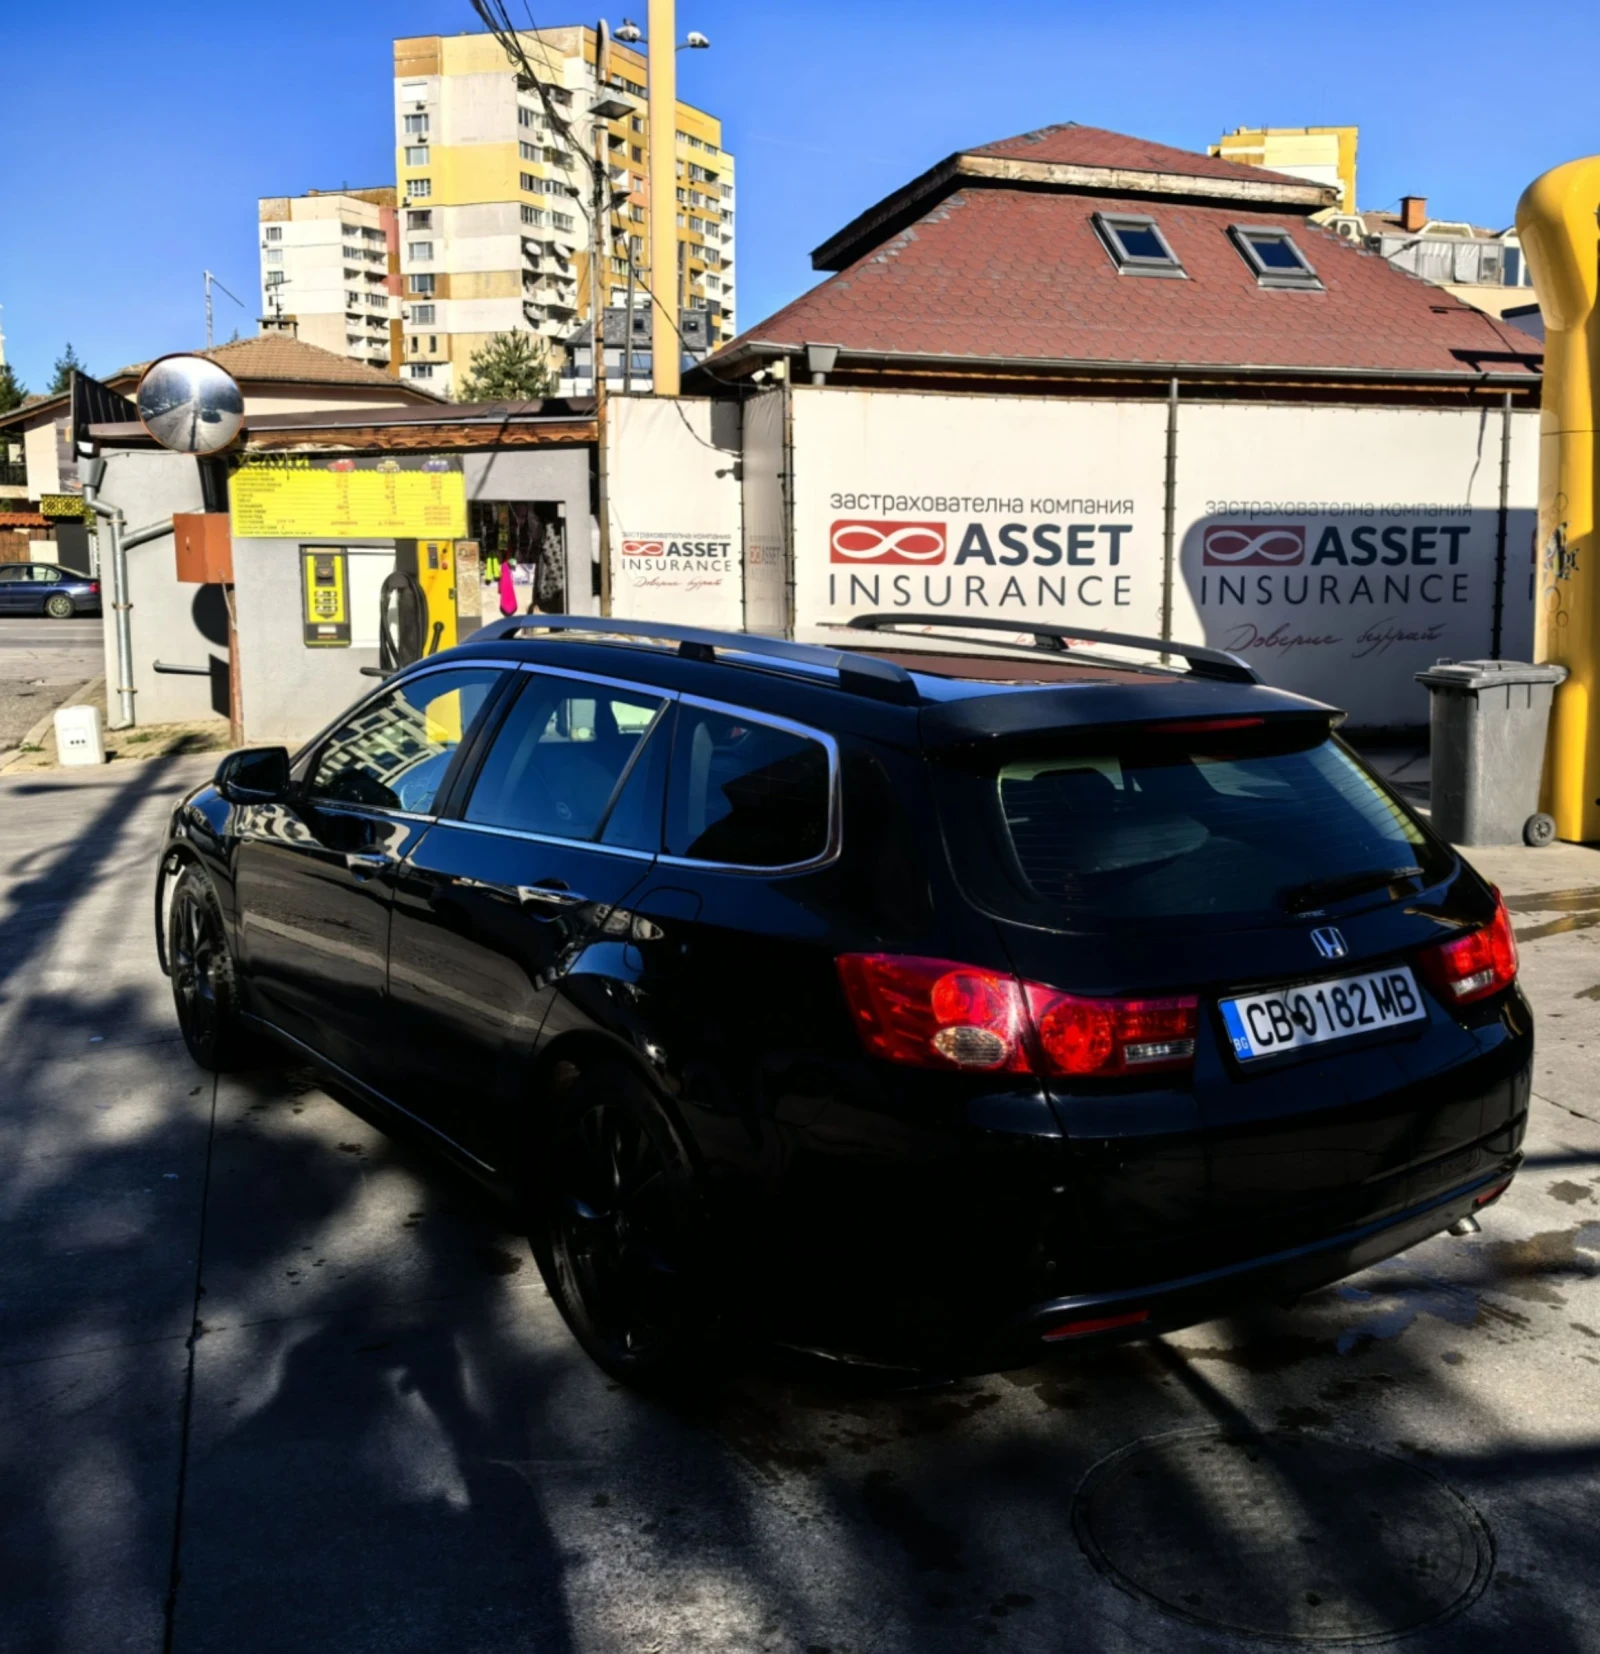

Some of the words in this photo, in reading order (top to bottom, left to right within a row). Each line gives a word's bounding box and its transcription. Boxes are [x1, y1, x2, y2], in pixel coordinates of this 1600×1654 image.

[830, 493, 1024, 515] застрахователна
[1031, 497, 1134, 514] компания
[1205, 500, 1375, 520] застрахователна
[1380, 503, 1472, 517] компания
[666, 541, 731, 558] ASSET
[953, 522, 1133, 566] ASSET
[1310, 526, 1471, 566] ASSET
[622, 558, 732, 572] INSURANCE
[830, 573, 1131, 606] INSURANCE
[1200, 573, 1469, 605] INSURANCE
[1223, 622, 1343, 660] Доверие
[1233, 1036, 1249, 1051] BG
